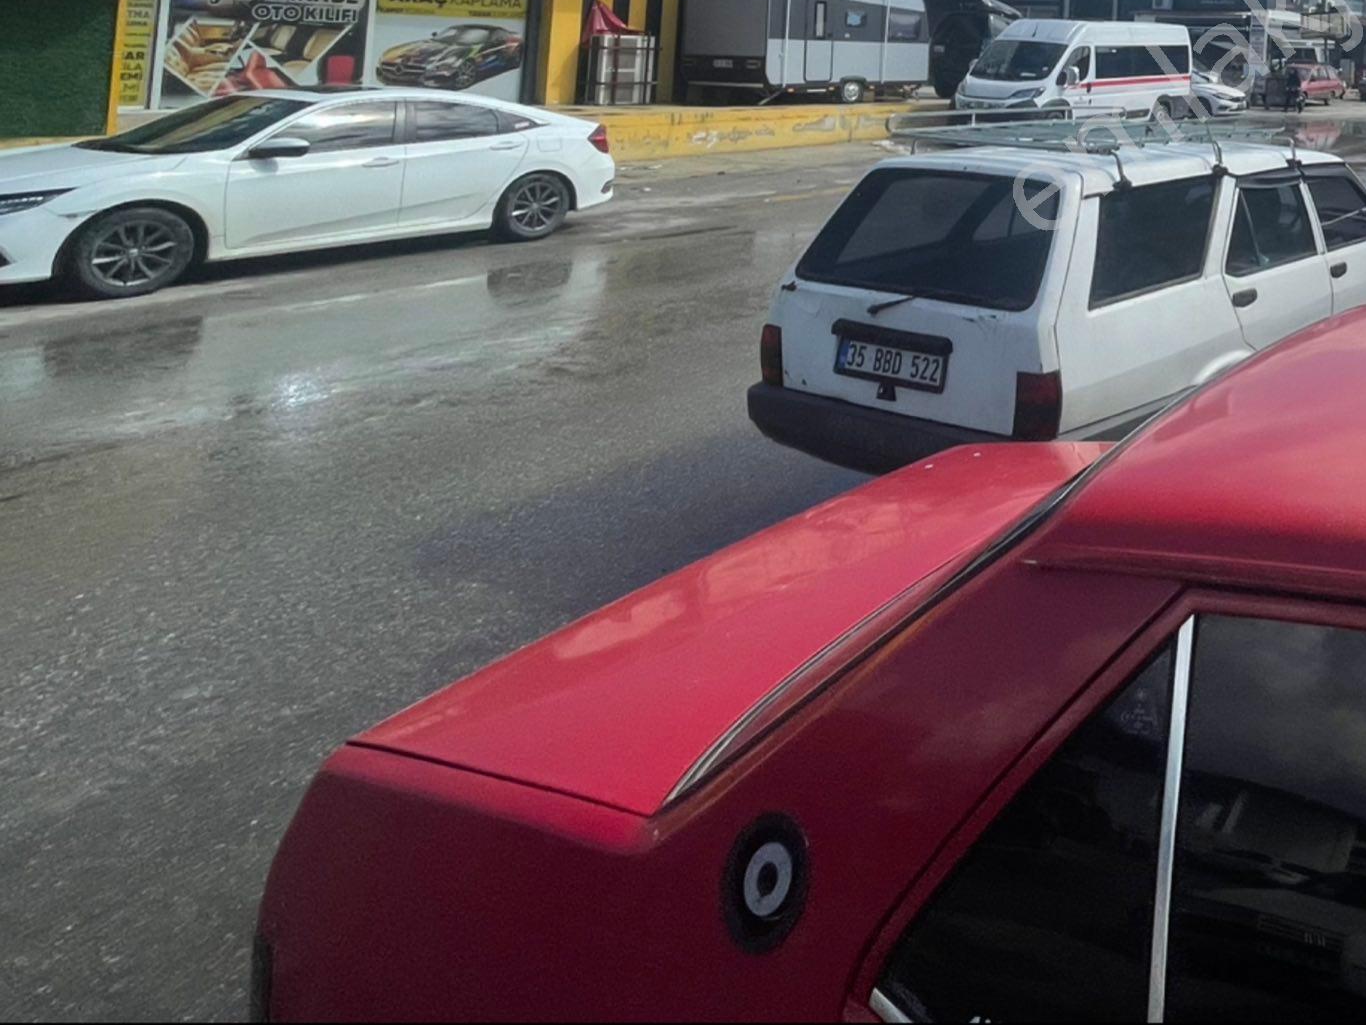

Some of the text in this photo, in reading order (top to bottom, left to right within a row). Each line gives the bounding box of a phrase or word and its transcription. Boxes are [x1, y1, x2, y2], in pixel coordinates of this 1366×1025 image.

[253, 4, 359, 23] OTO KILIFI
[847, 343, 940, 383] 35 BBD 522
